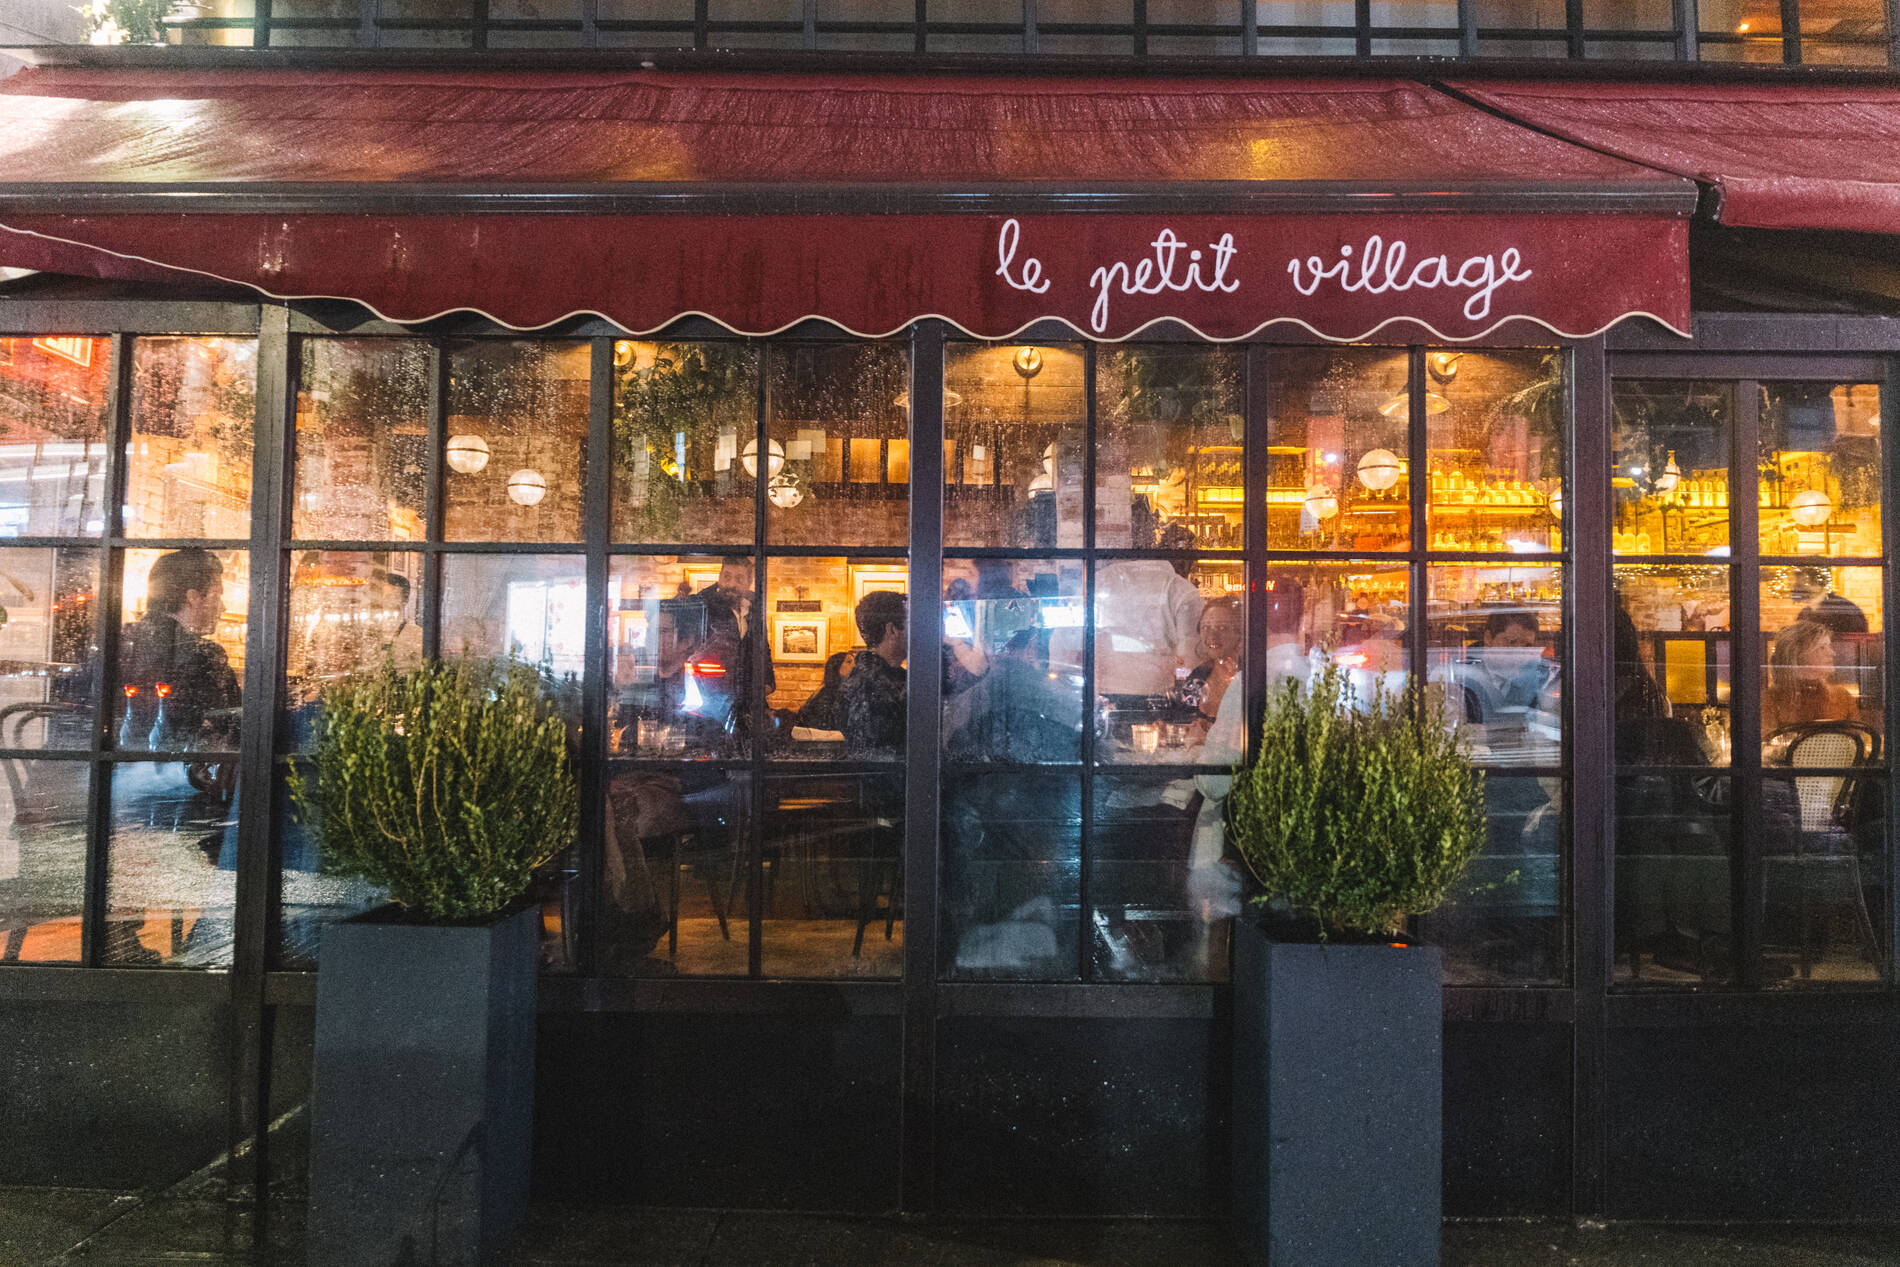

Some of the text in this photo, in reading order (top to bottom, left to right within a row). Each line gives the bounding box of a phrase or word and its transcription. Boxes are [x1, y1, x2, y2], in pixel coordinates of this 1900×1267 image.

[995, 218, 1533, 333] le petit village
